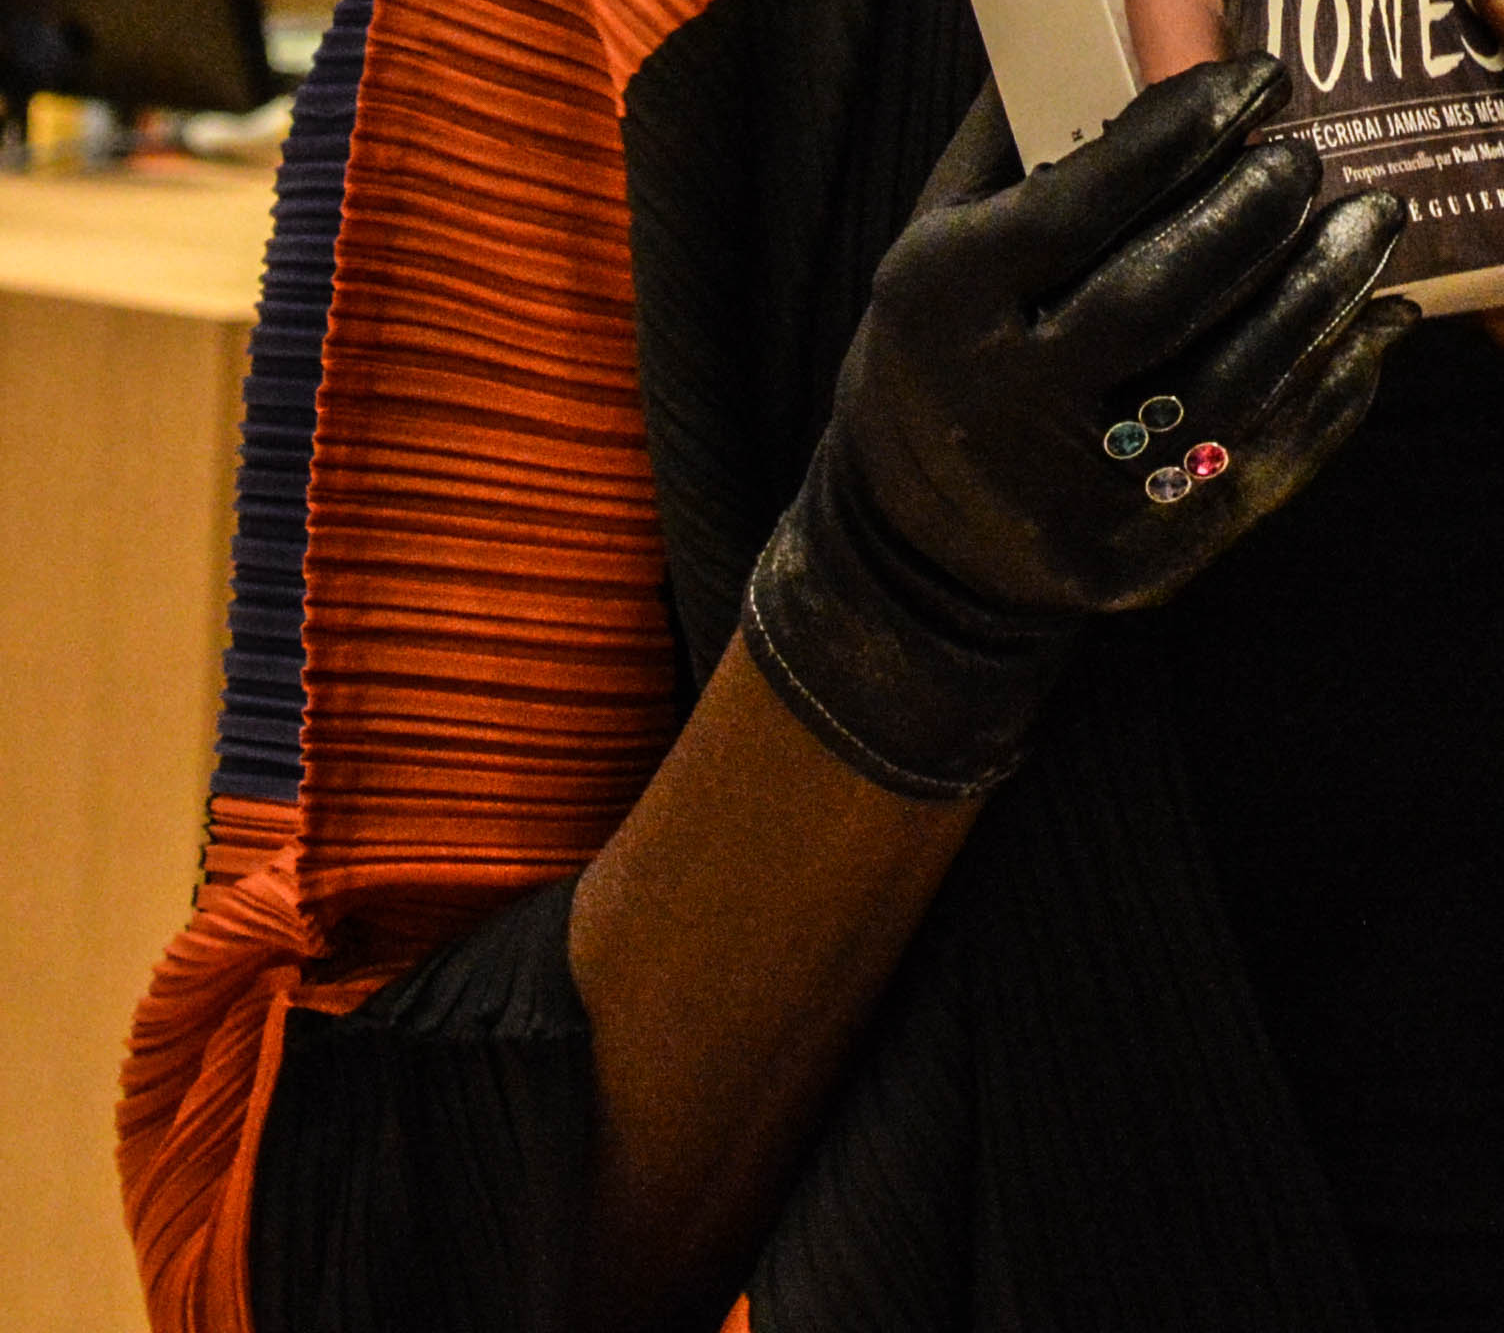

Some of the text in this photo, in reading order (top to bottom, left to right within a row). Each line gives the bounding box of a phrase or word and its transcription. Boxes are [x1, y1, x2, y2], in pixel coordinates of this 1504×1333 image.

[1385, 109, 1441, 136] JAMAIS
[1442, 101, 1475, 128] MES
[1342, 164, 1385, 185] Propos
[1452, 143, 1478, 164] Paul
